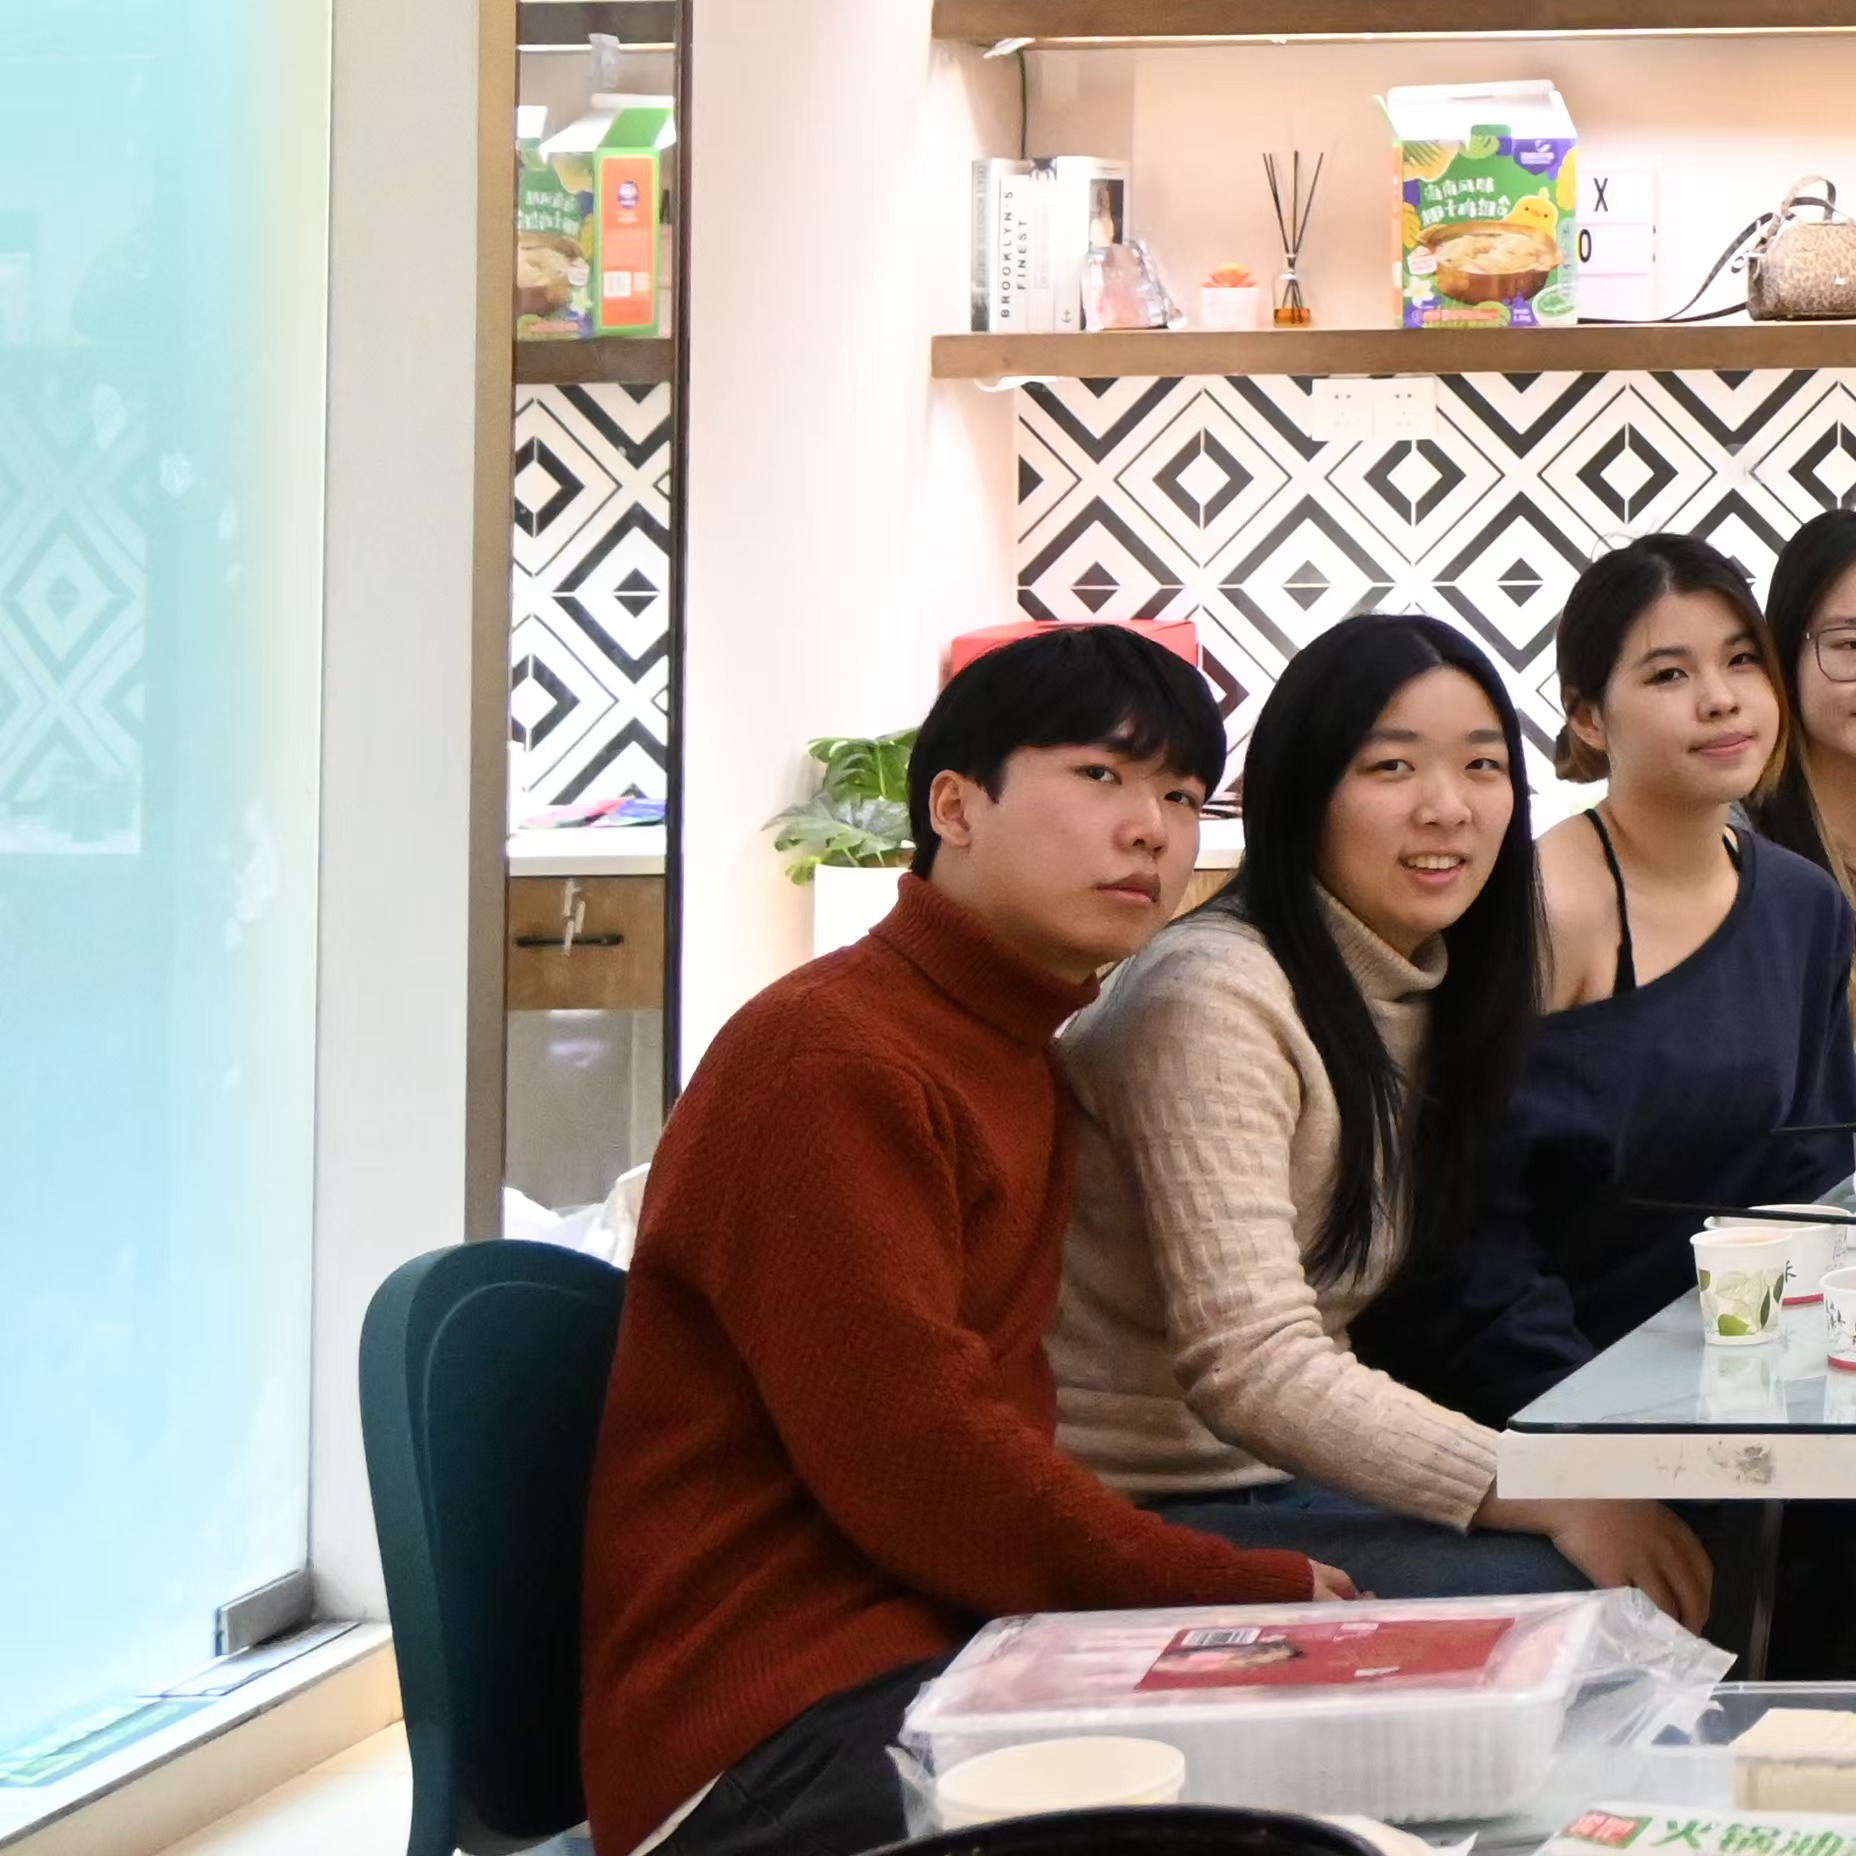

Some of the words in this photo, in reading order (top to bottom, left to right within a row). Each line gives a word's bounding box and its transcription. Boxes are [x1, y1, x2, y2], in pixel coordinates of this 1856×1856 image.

[1593, 177, 1609, 213] X
[1001, 191, 1013, 318] BROOKLYN'S
[1017, 220, 1028, 290] FINEST
